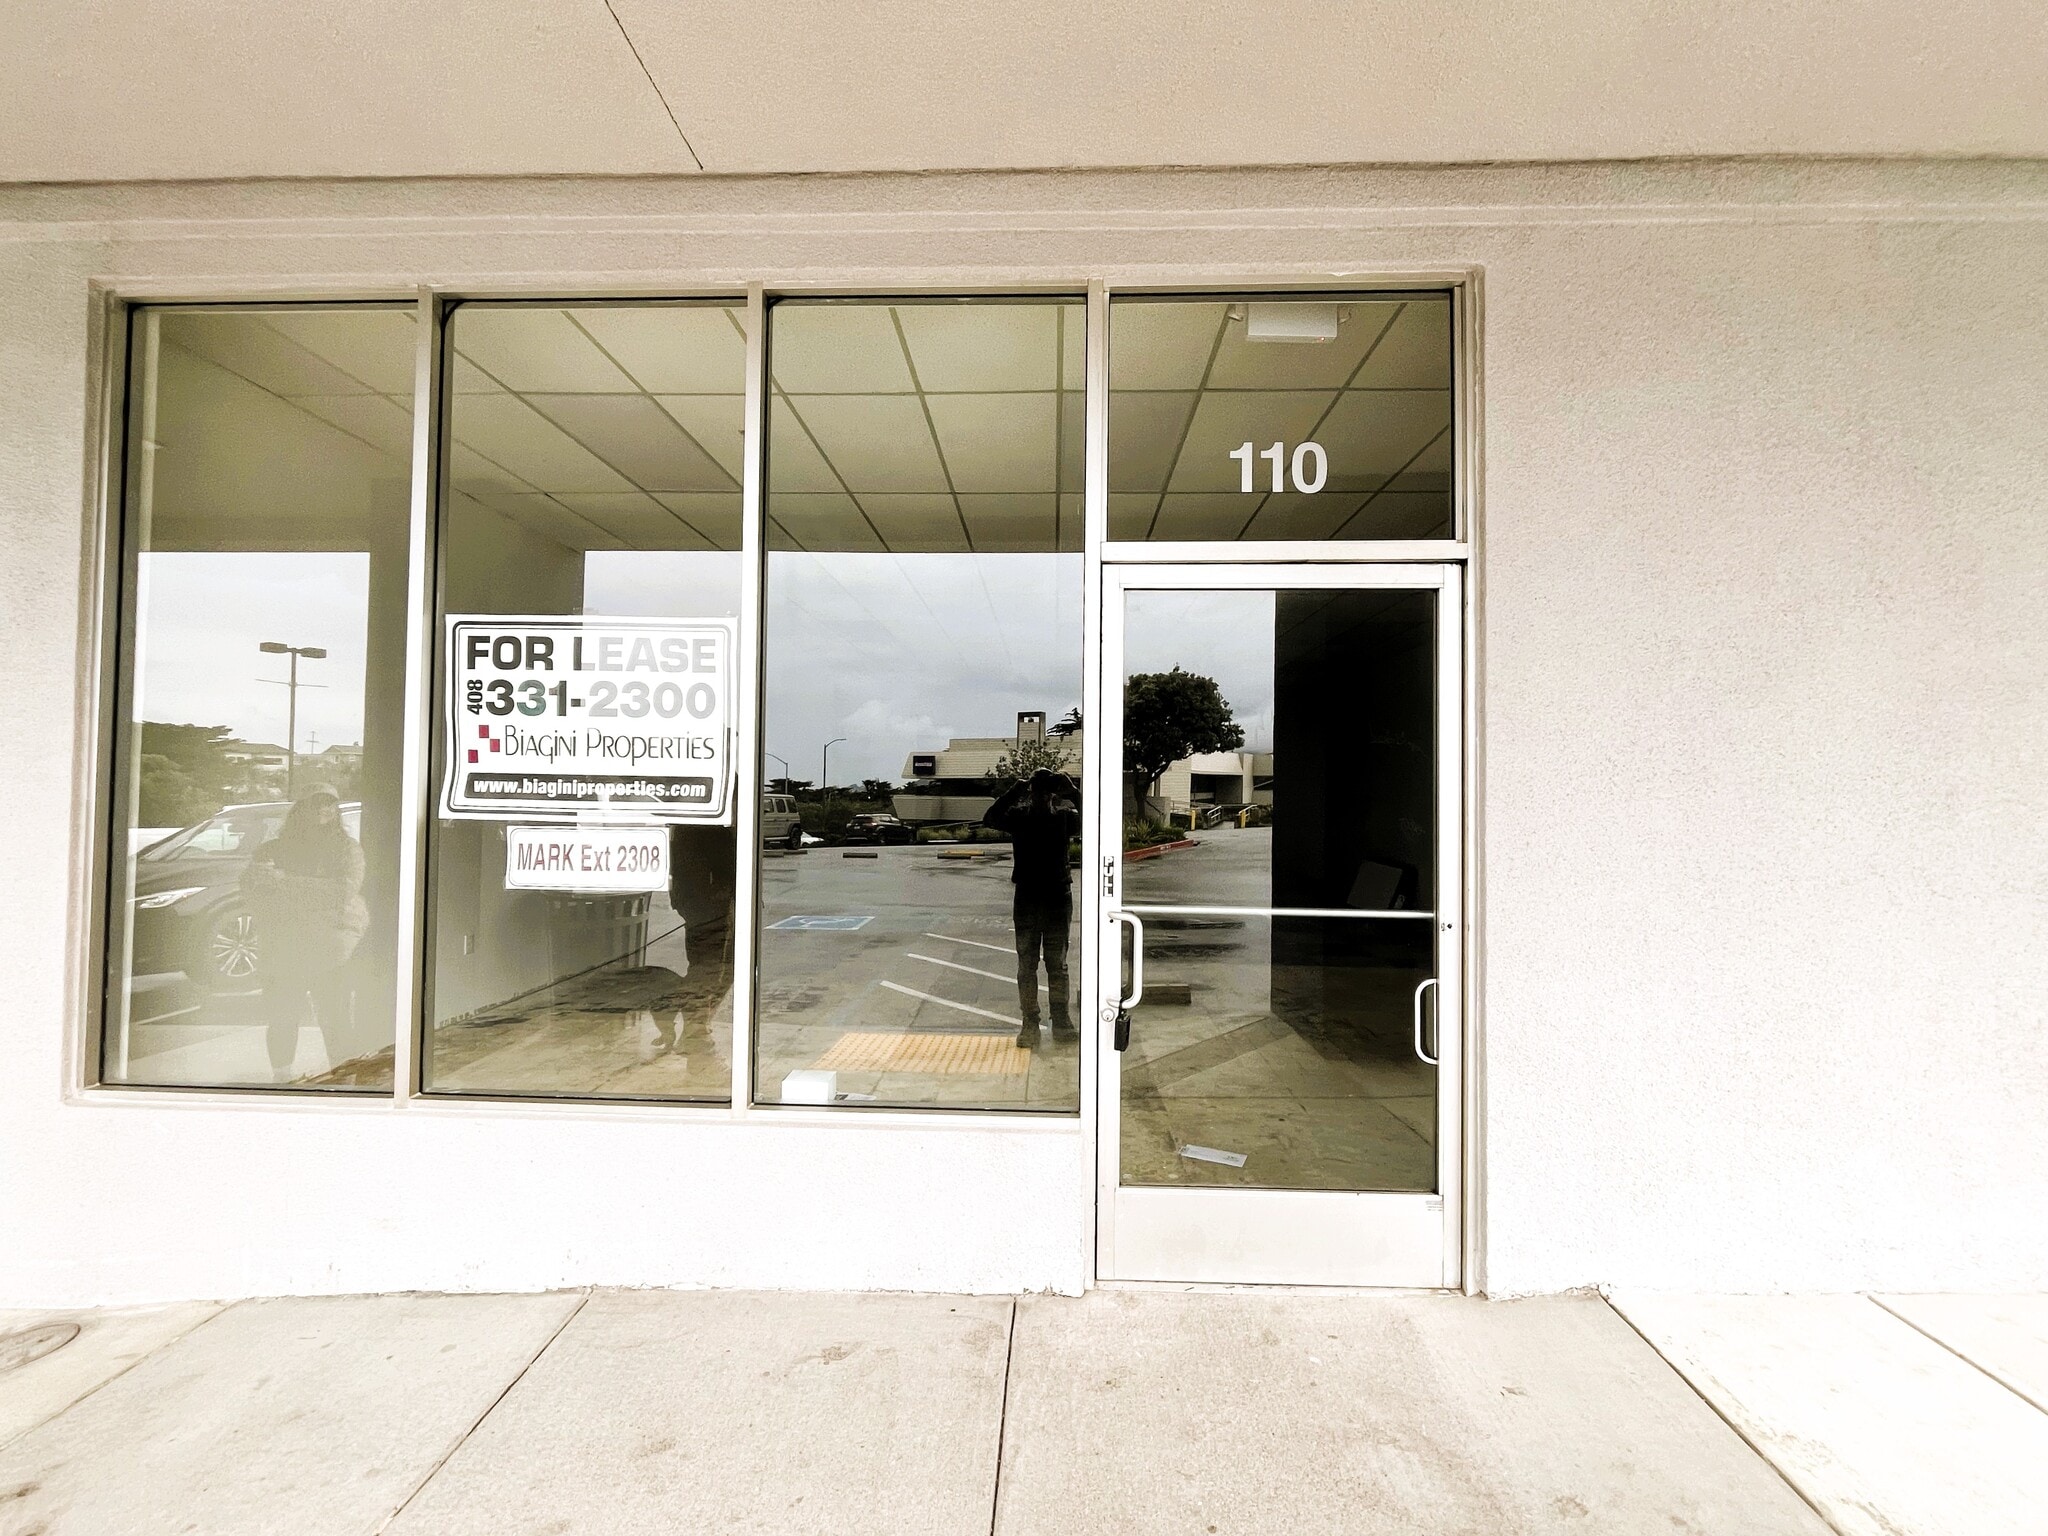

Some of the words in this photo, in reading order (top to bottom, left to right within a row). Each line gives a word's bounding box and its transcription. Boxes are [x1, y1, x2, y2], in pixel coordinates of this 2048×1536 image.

[1229, 441, 1328, 494] 110
[467, 635, 554, 671] FOR
[573, 636, 717, 674] LEASE
[467, 679, 483, 716] 408
[485, 679, 716, 719] 331-2300
[473, 778, 706, 798] www.biaginiproperties.com
[516, 843, 574, 872] MARK
[581, 844, 611, 872] Ext
[617, 845, 660, 873] 2308
[1103, 855, 1114, 897] PULL
